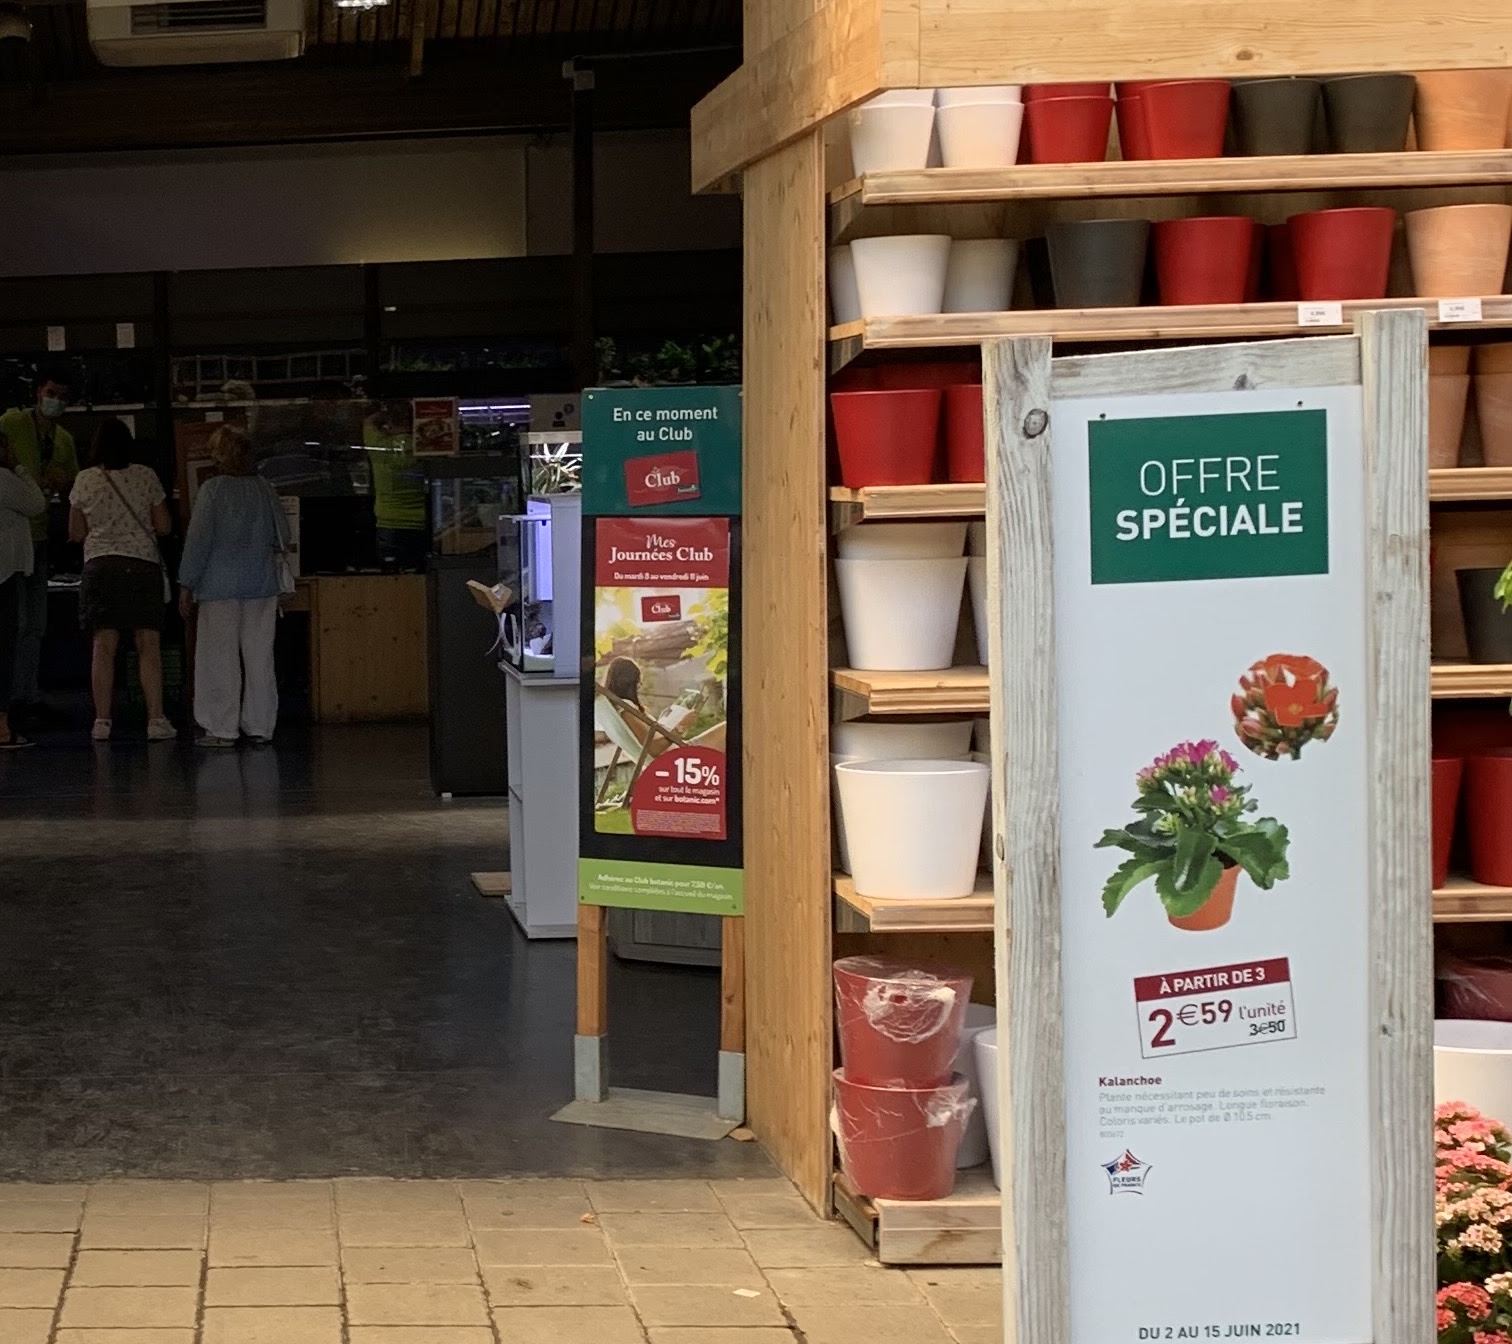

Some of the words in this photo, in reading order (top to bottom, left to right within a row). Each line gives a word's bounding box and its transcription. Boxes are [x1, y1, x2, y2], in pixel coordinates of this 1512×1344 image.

[613, 408, 631, 421] En
[636, 410, 652, 421] ce
[656, 407, 718, 421] moment
[637, 430, 654, 441] au
[659, 427, 692, 441] Club
[644, 471, 680, 488] Club
[1140, 455, 1280, 496] OFFRE
[1116, 498, 1303, 541] SPÉCIALE
[646, 534, 677, 549] Mes
[609, 547, 673, 564] Journées
[676, 547, 713, 561] Club
[1159, 977, 1171, 994] À
[1173, 972, 1229, 992] PARTIR
[1232, 969, 1253, 984] DE
[1255, 967, 1265, 981] 3
[1239, 1000, 1286, 1019] l'unité
[1098, 1075, 1162, 1087] Kalanchoe
[1099, 1092, 1132, 1102] Plante
[1196, 1091, 1215, 1101] peu
[1218, 1088, 1231, 1098] de
[1114, 1104, 1155, 1115] manque
[1139, 1327, 1160, 1340] DU
[1165, 1327, 1173, 1339] 2
[1178, 1326, 1199, 1339] AU
[1204, 1325, 1220, 1338] 15
[1225, 1324, 1261, 1337] JUIN
[1266, 1323, 1300, 1336] 2021
